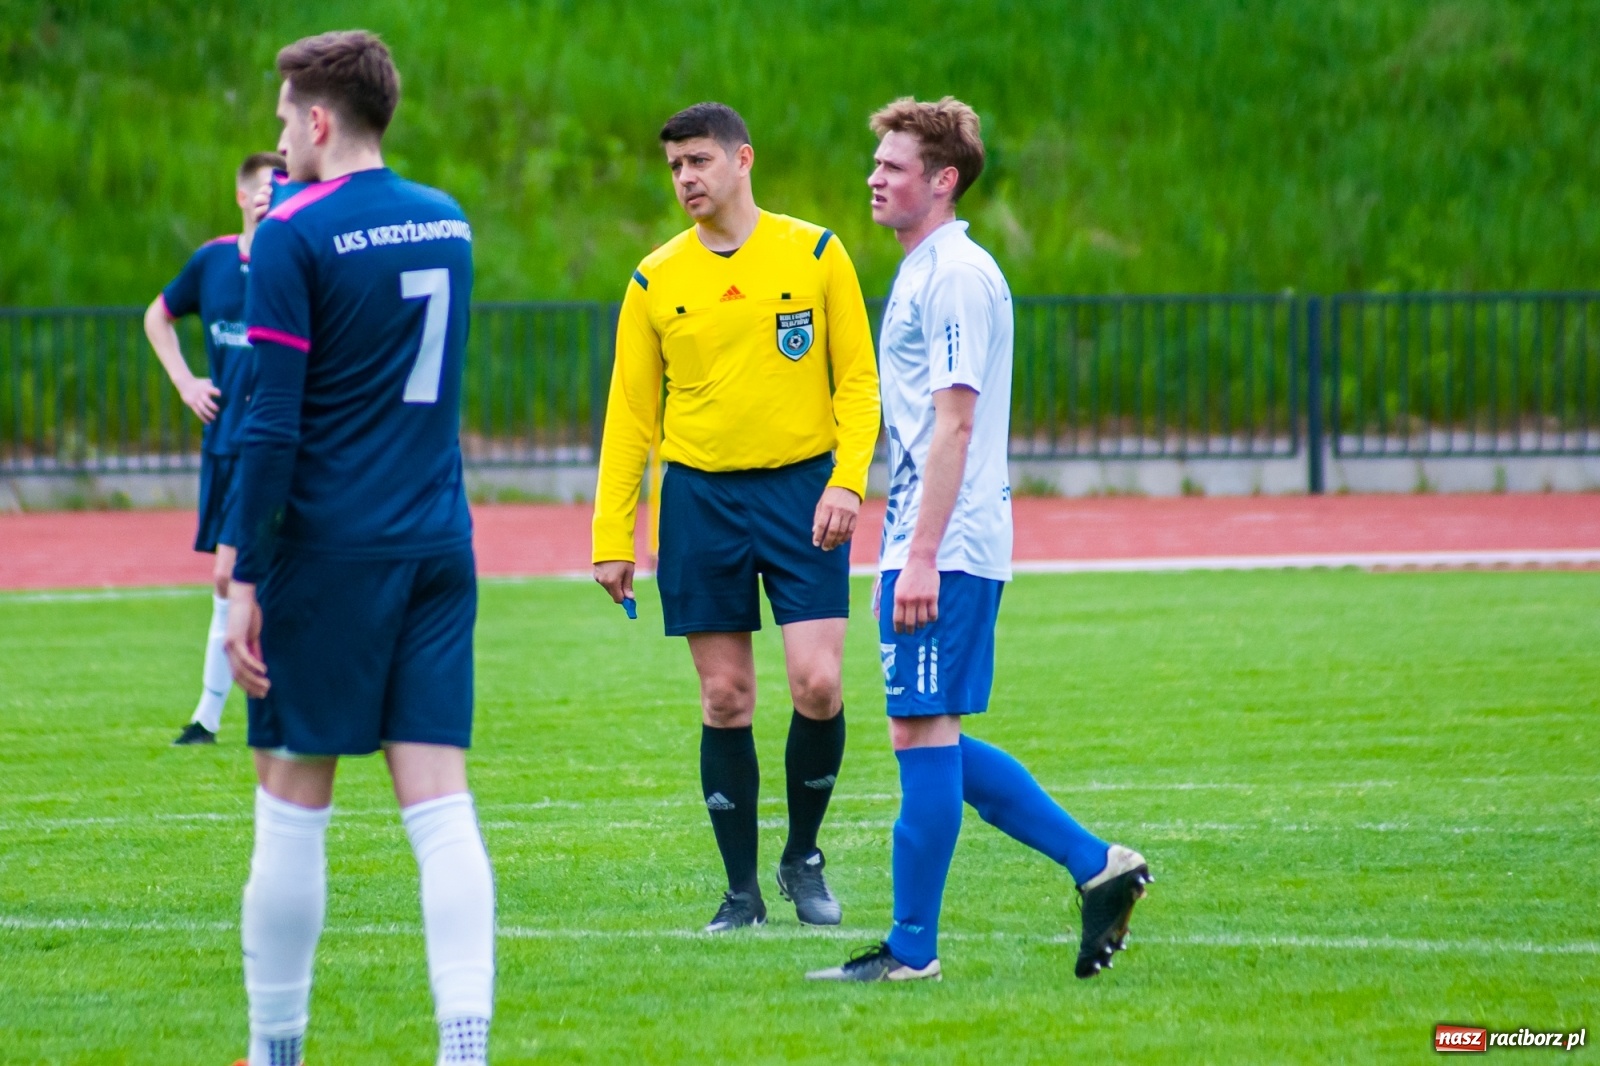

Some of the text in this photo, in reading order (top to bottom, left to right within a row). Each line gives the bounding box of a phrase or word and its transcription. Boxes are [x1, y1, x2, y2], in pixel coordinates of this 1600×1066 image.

[333, 219, 472, 254] LKS KRZYŻANOWIC
[400, 267, 450, 403] 7
